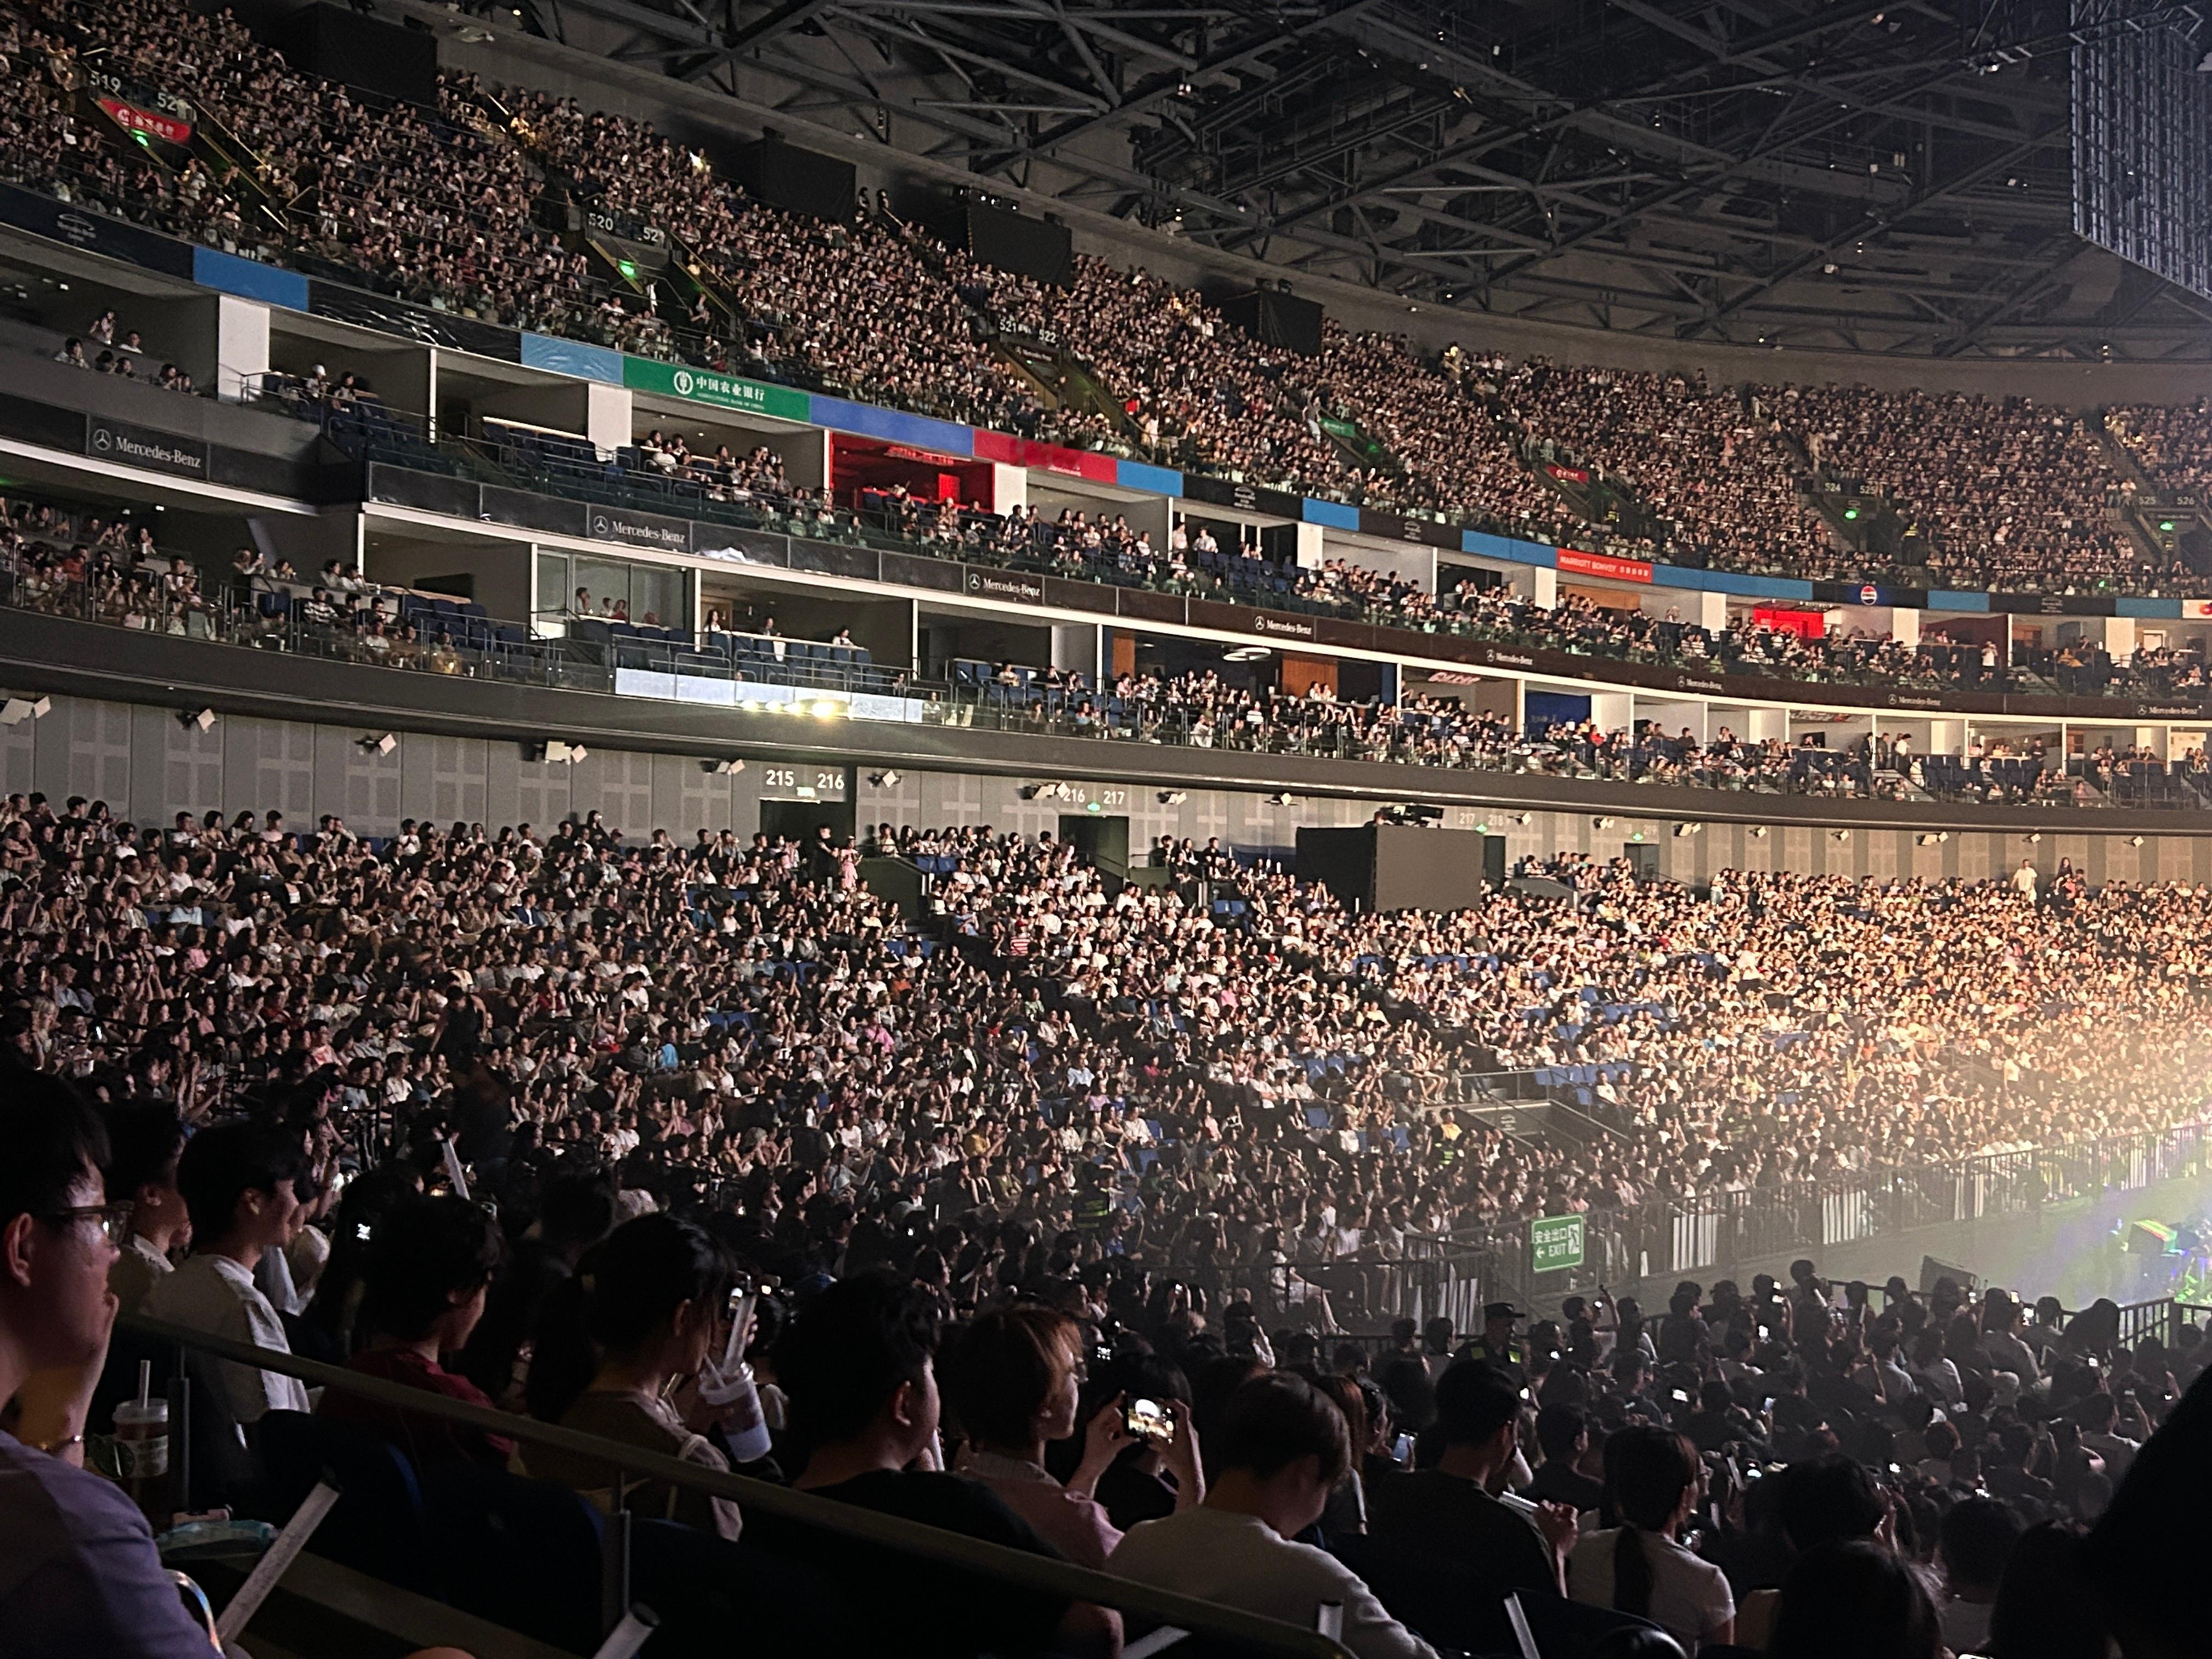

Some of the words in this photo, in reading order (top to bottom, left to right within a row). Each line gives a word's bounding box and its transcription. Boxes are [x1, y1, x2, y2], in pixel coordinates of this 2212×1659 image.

[91, 70, 121, 92] 519
[588, 212, 613, 231] 520
[1000, 318, 1017, 333] 521
[1039, 329, 1056, 343] 522
[696, 376, 765, 401] 中国农业银行
[116, 436, 201, 468] Mercedes-Benz
[2139, 496, 2155, 505] 525
[2177, 496, 2194, 505] 526
[612, 521, 685, 543] Mercedes-Benz
[983, 578, 1040, 597] Mercedes-Benz
[1266, 619, 1312, 635] Mercedes-Benz
[1898, 696, 1941, 706] Mercedes-Benz
[2149, 706, 2198, 714] Mercedes-Benz
[766, 770, 794, 787] 215
[817, 773, 845, 790] 216
[1062, 788, 1086, 803] 216
[1103, 790, 1125, 805] 217
[1459, 812, 1475, 825] 217
[1535, 1228, 1567, 1244] 安全出口
[1549, 1244, 1567, 1257] EXIT
